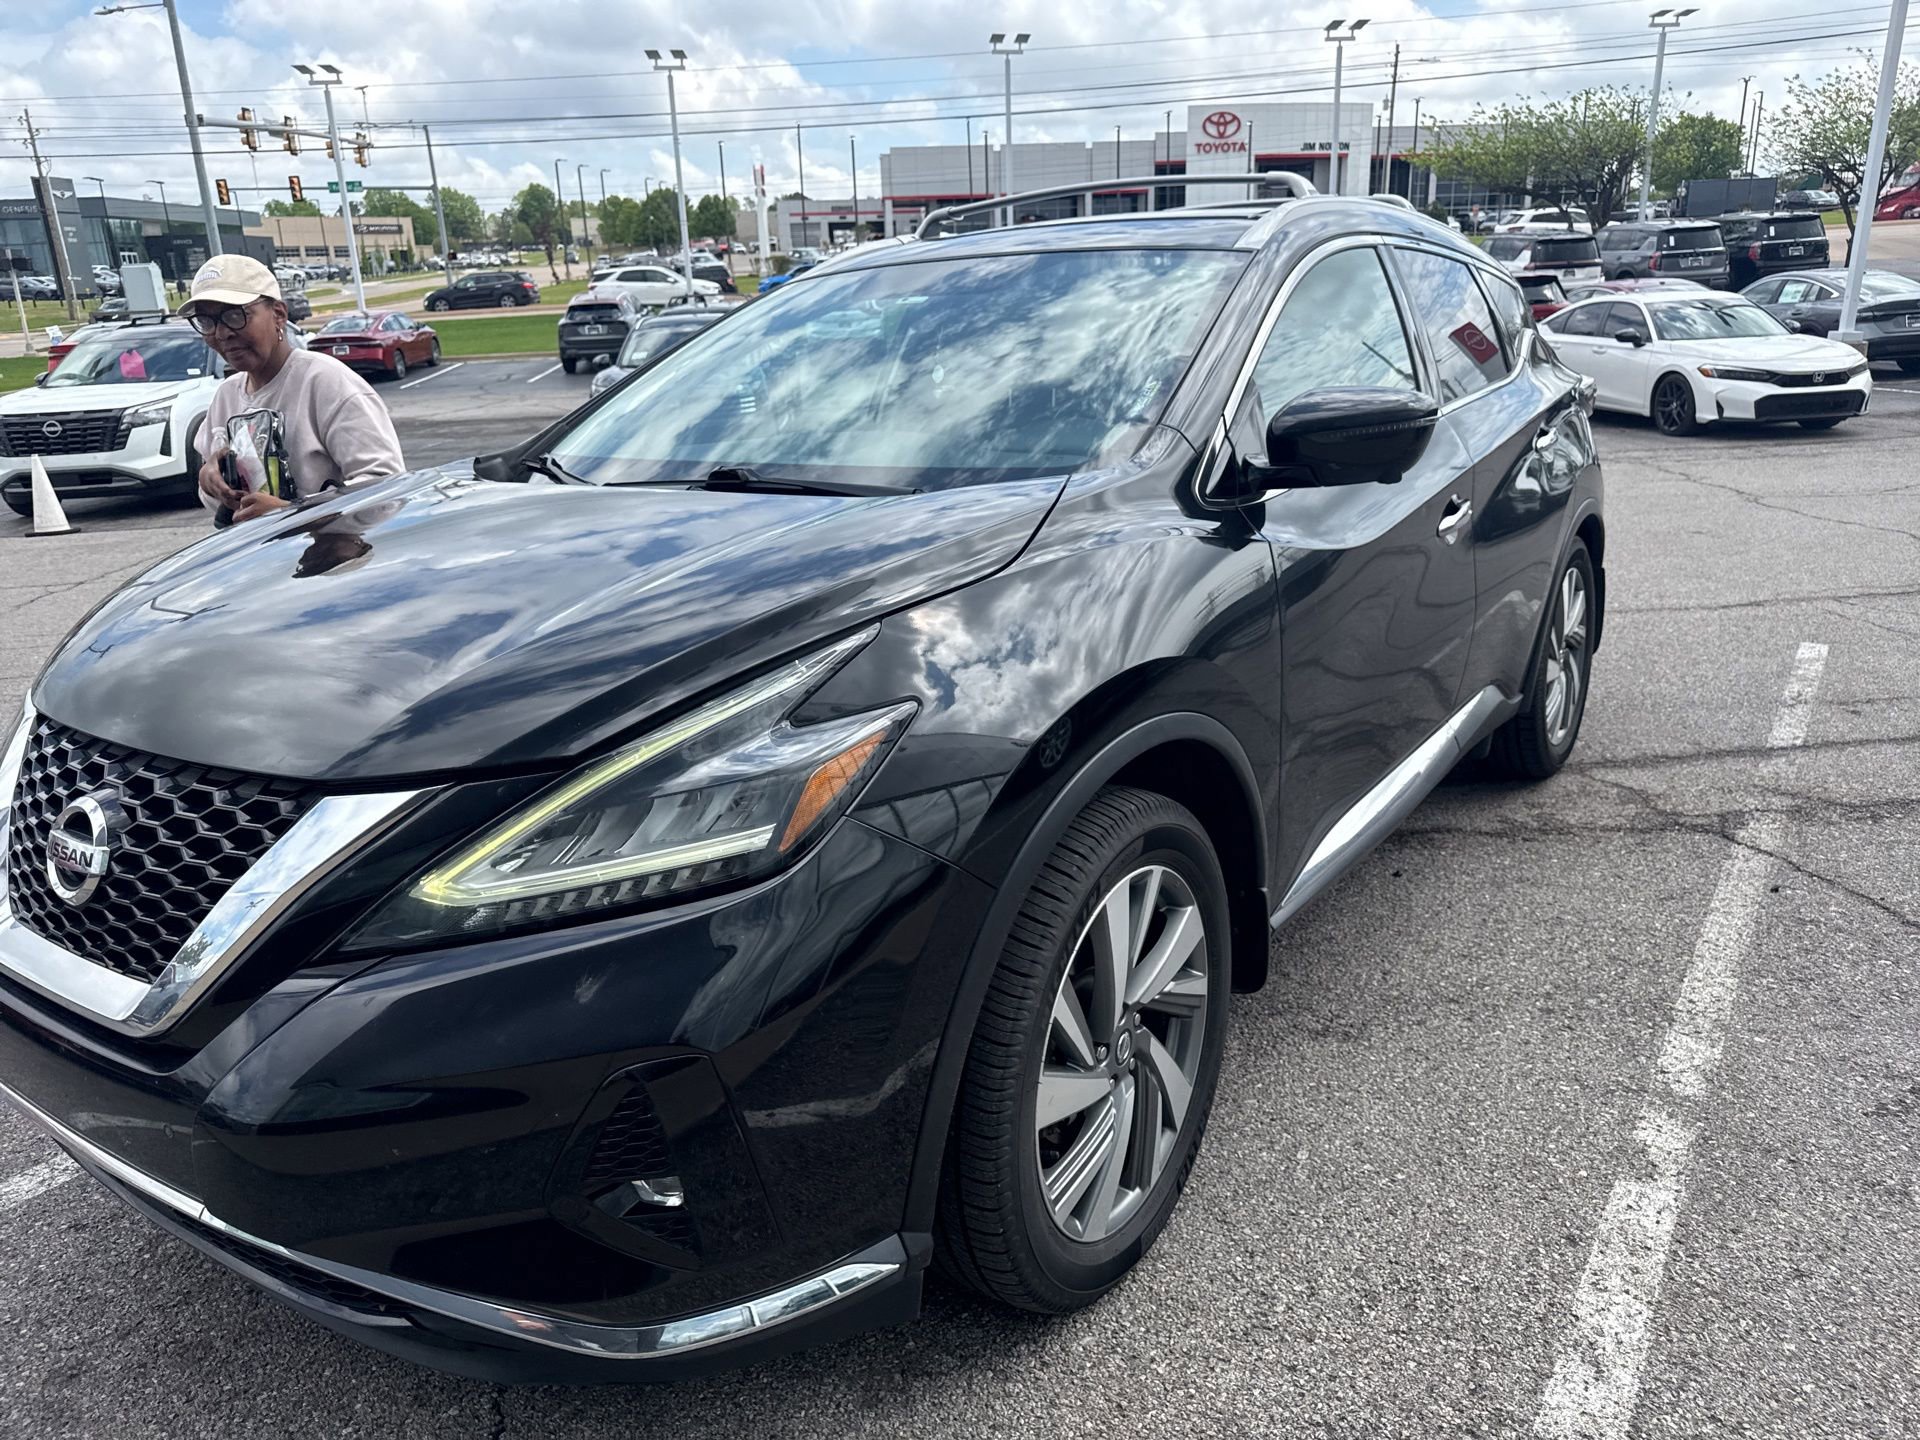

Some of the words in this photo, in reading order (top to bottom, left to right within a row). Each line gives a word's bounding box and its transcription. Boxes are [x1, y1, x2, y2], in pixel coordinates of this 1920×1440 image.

[1195, 141, 1247, 154] TOYOTA
[1300, 142, 1316, 151] JIM
[1318, 141, 1350, 151] NOON
[2, 204, 38, 213] GENESIS
